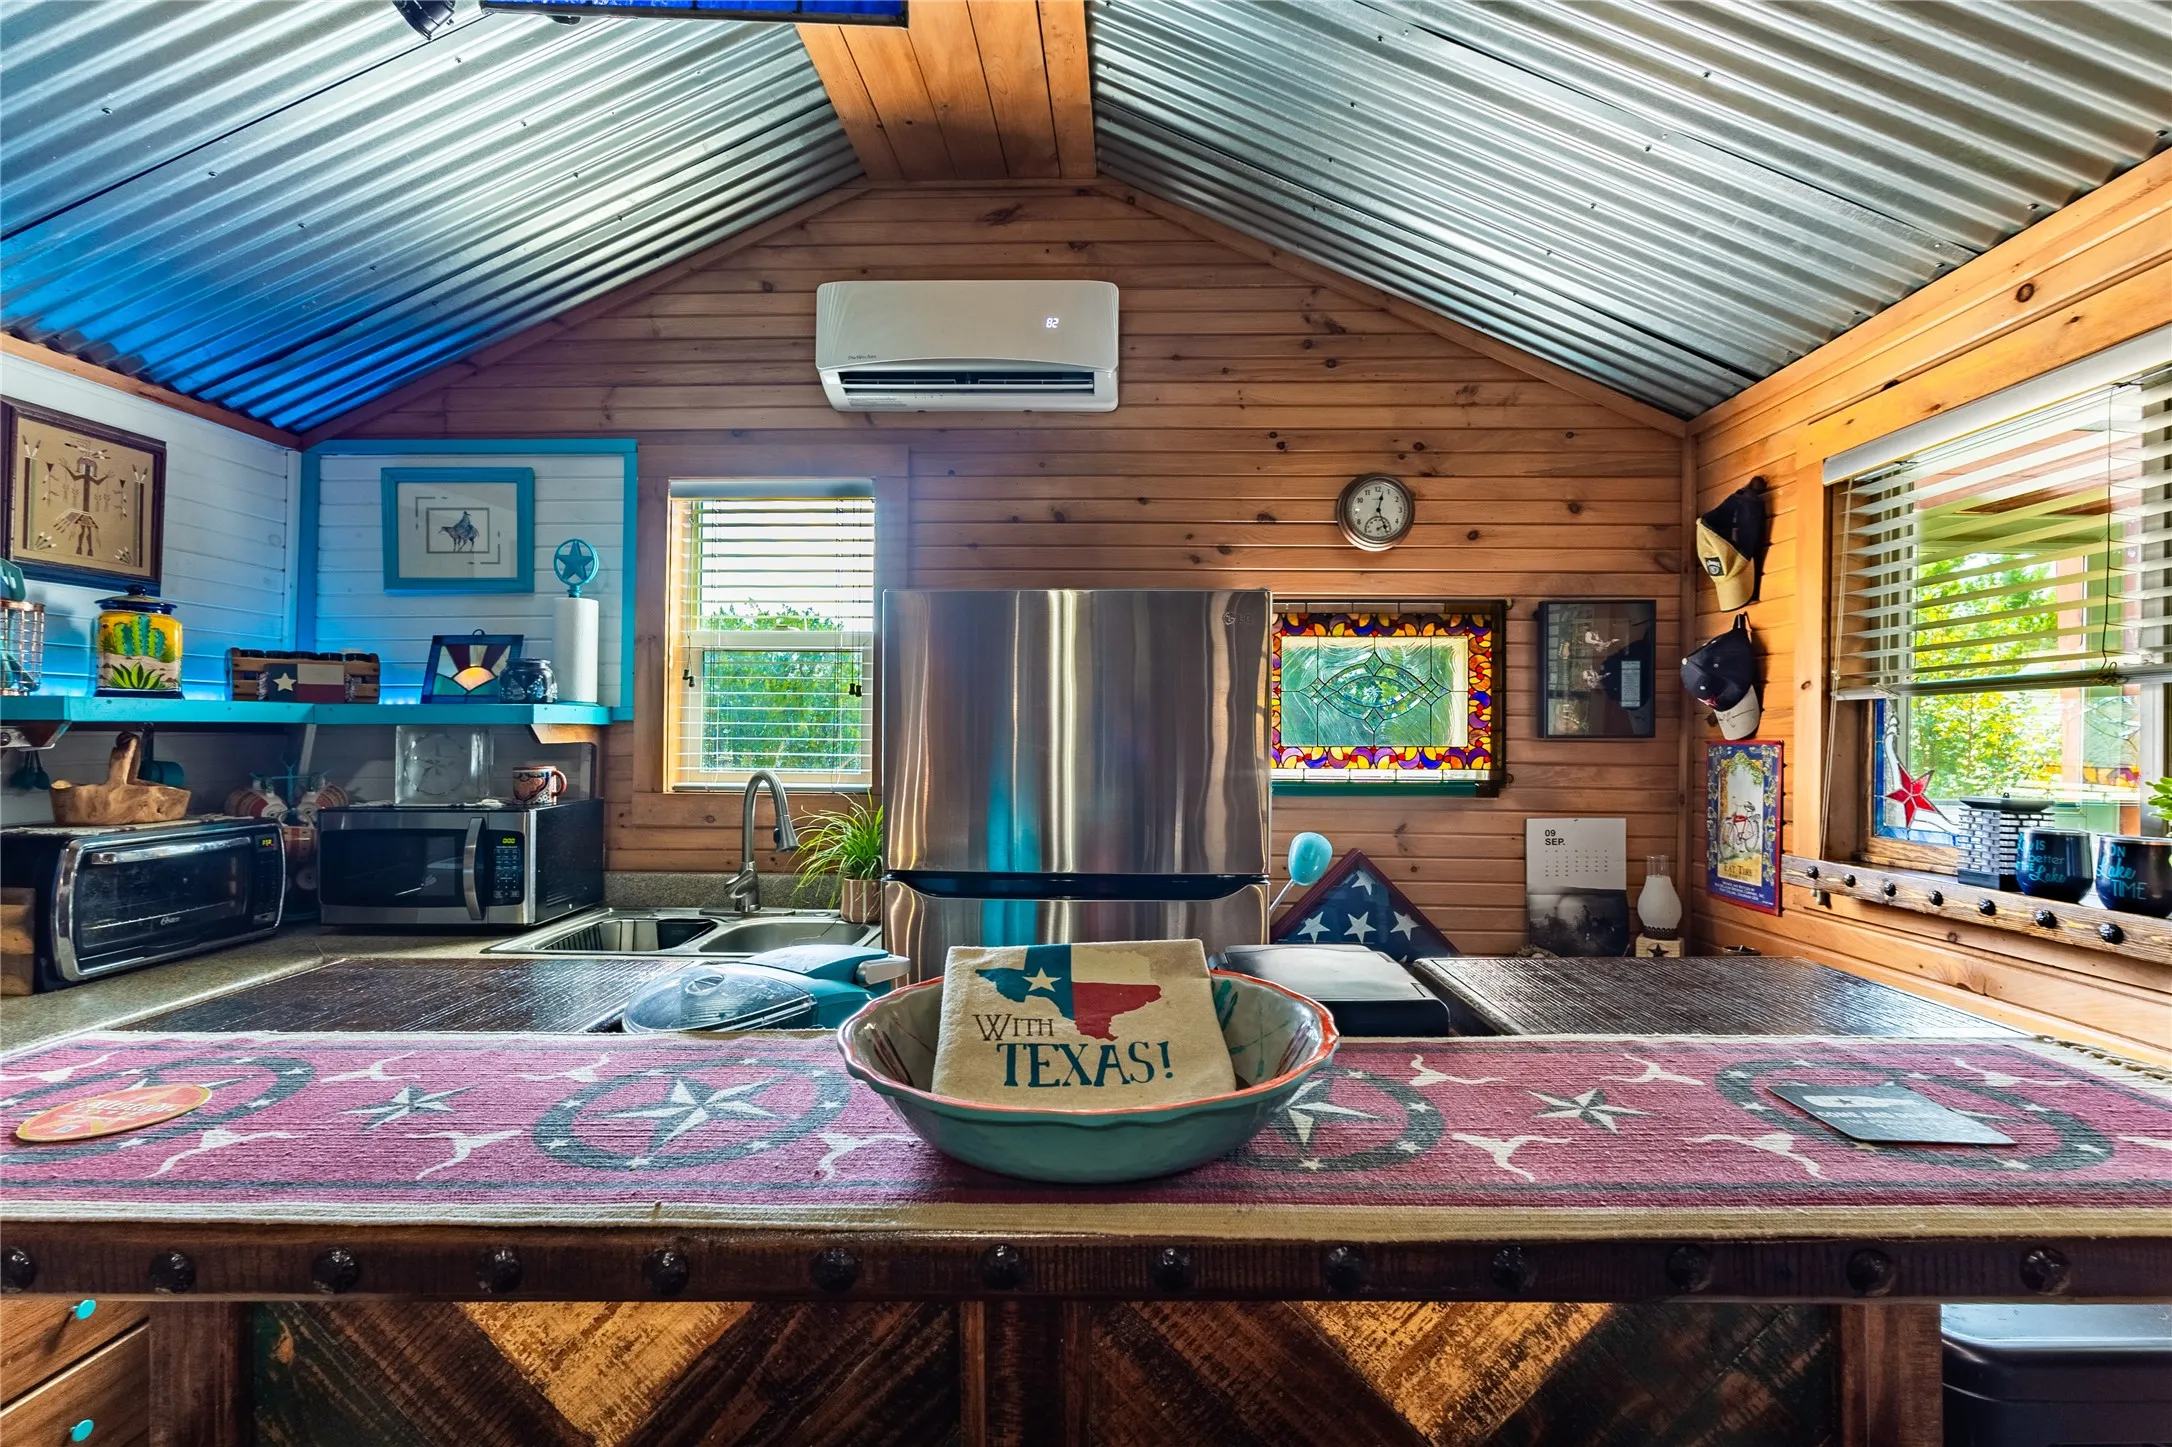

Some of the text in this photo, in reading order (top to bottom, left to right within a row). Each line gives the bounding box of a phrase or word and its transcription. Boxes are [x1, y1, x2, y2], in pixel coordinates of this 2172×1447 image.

[1045, 317, 1059, 328] 82
[1545, 829, 1556, 837] 09
[1545, 838, 1566, 846] SEP.
[2036, 839, 2046, 850] IS
[2107, 843, 2126, 857] ON
[2028, 853, 2065, 864] better
[2096, 853, 2136, 879] Lake
[2029, 865, 2066, 883] Lake
[2111, 880, 2148, 899] TIME
[972, 1014, 1054, 1041] WITH
[996, 1041, 1174, 1087] TEXAS!
